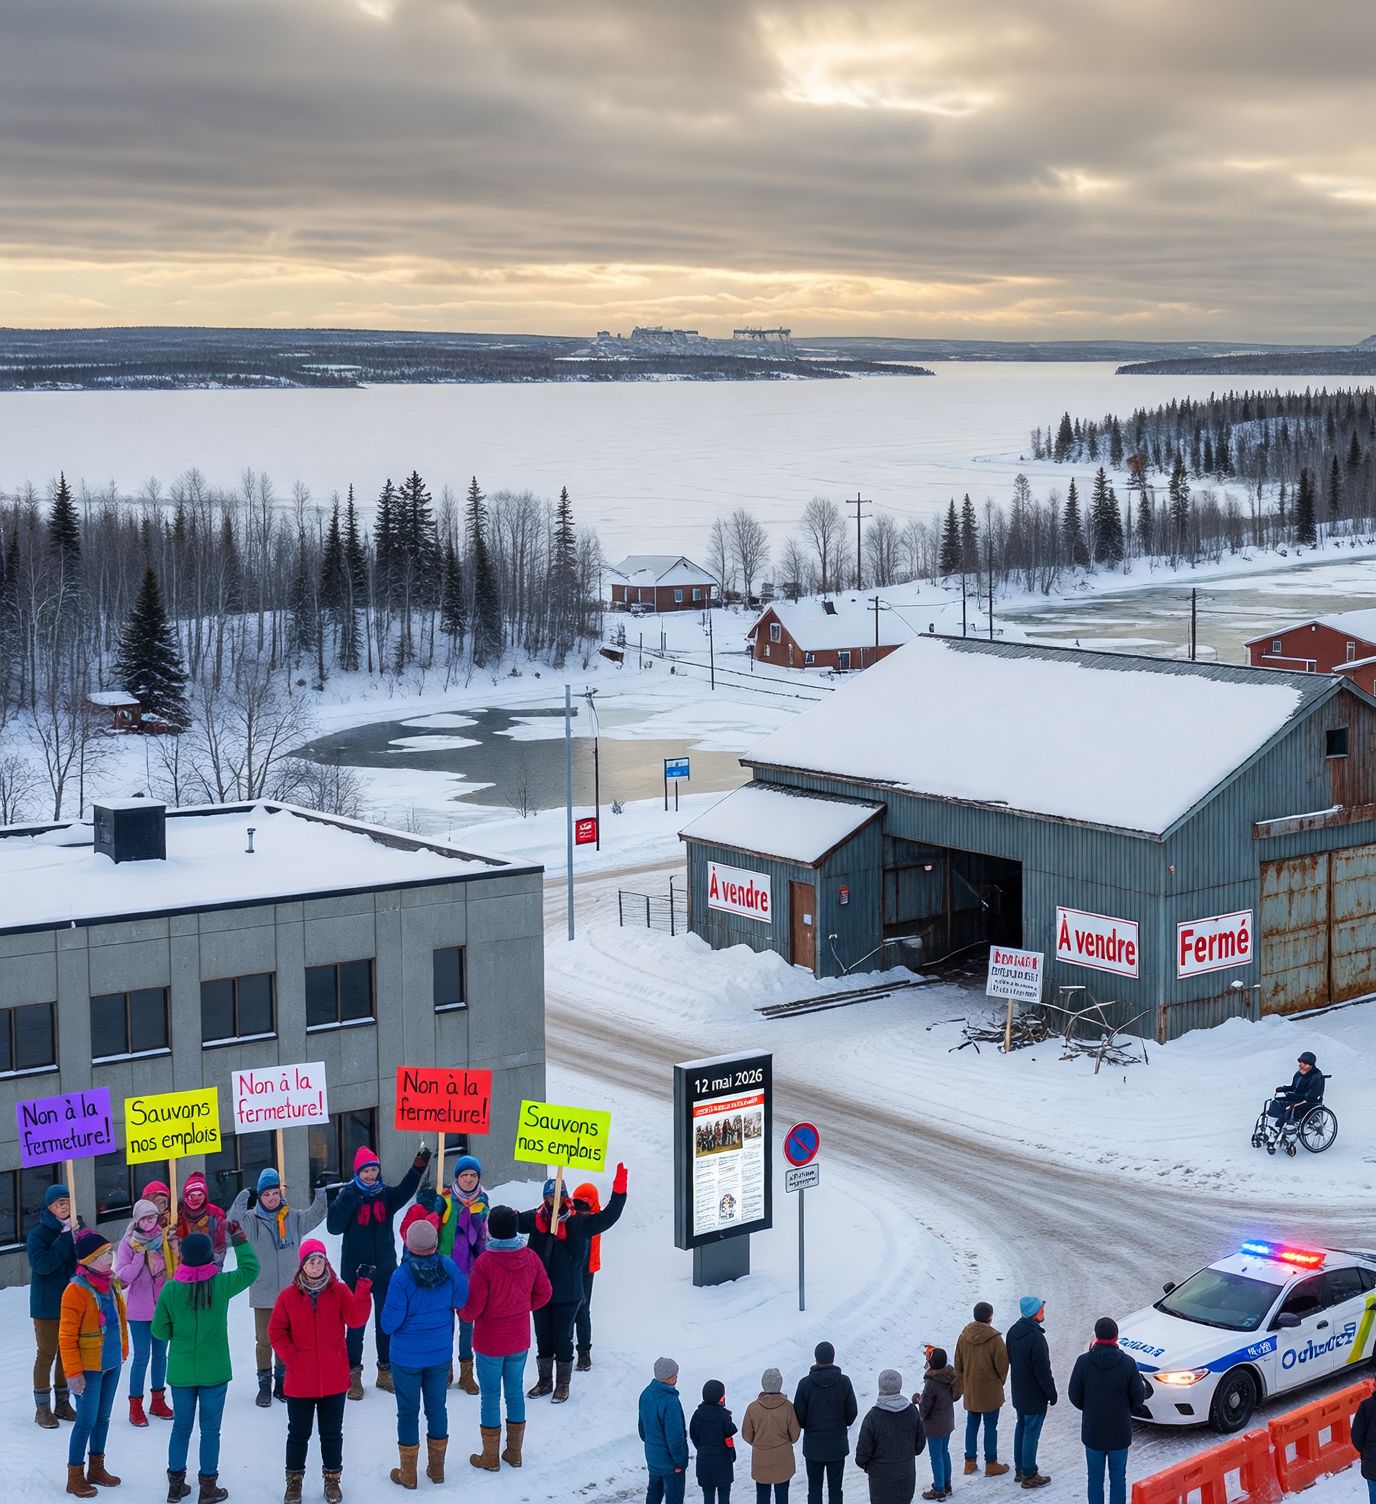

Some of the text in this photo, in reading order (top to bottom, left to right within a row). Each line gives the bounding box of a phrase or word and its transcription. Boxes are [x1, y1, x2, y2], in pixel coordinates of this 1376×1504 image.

[709, 866, 769, 912] À vendre
[1058, 913, 1071, 952] À
[1075, 928, 1136, 966] vendre
[1180, 919, 1249, 966] Fermé
[239, 1067, 312, 1096] Non à la
[403, 1070, 479, 1096] Non à la
[694, 1068, 763, 1094] 12 mai 2026
[22, 1094, 98, 1127] Non à la
[130, 1100, 210, 1126] Sauvons
[236, 1091, 323, 1124] fermeture!
[400, 1096, 488, 1125] fermeture!
[524, 1105, 598, 1136] Sauvons
[24, 1117, 111, 1156] fermeture!
[130, 1122, 217, 1154] nos emplois
[518, 1136, 601, 1164] nos emplois
